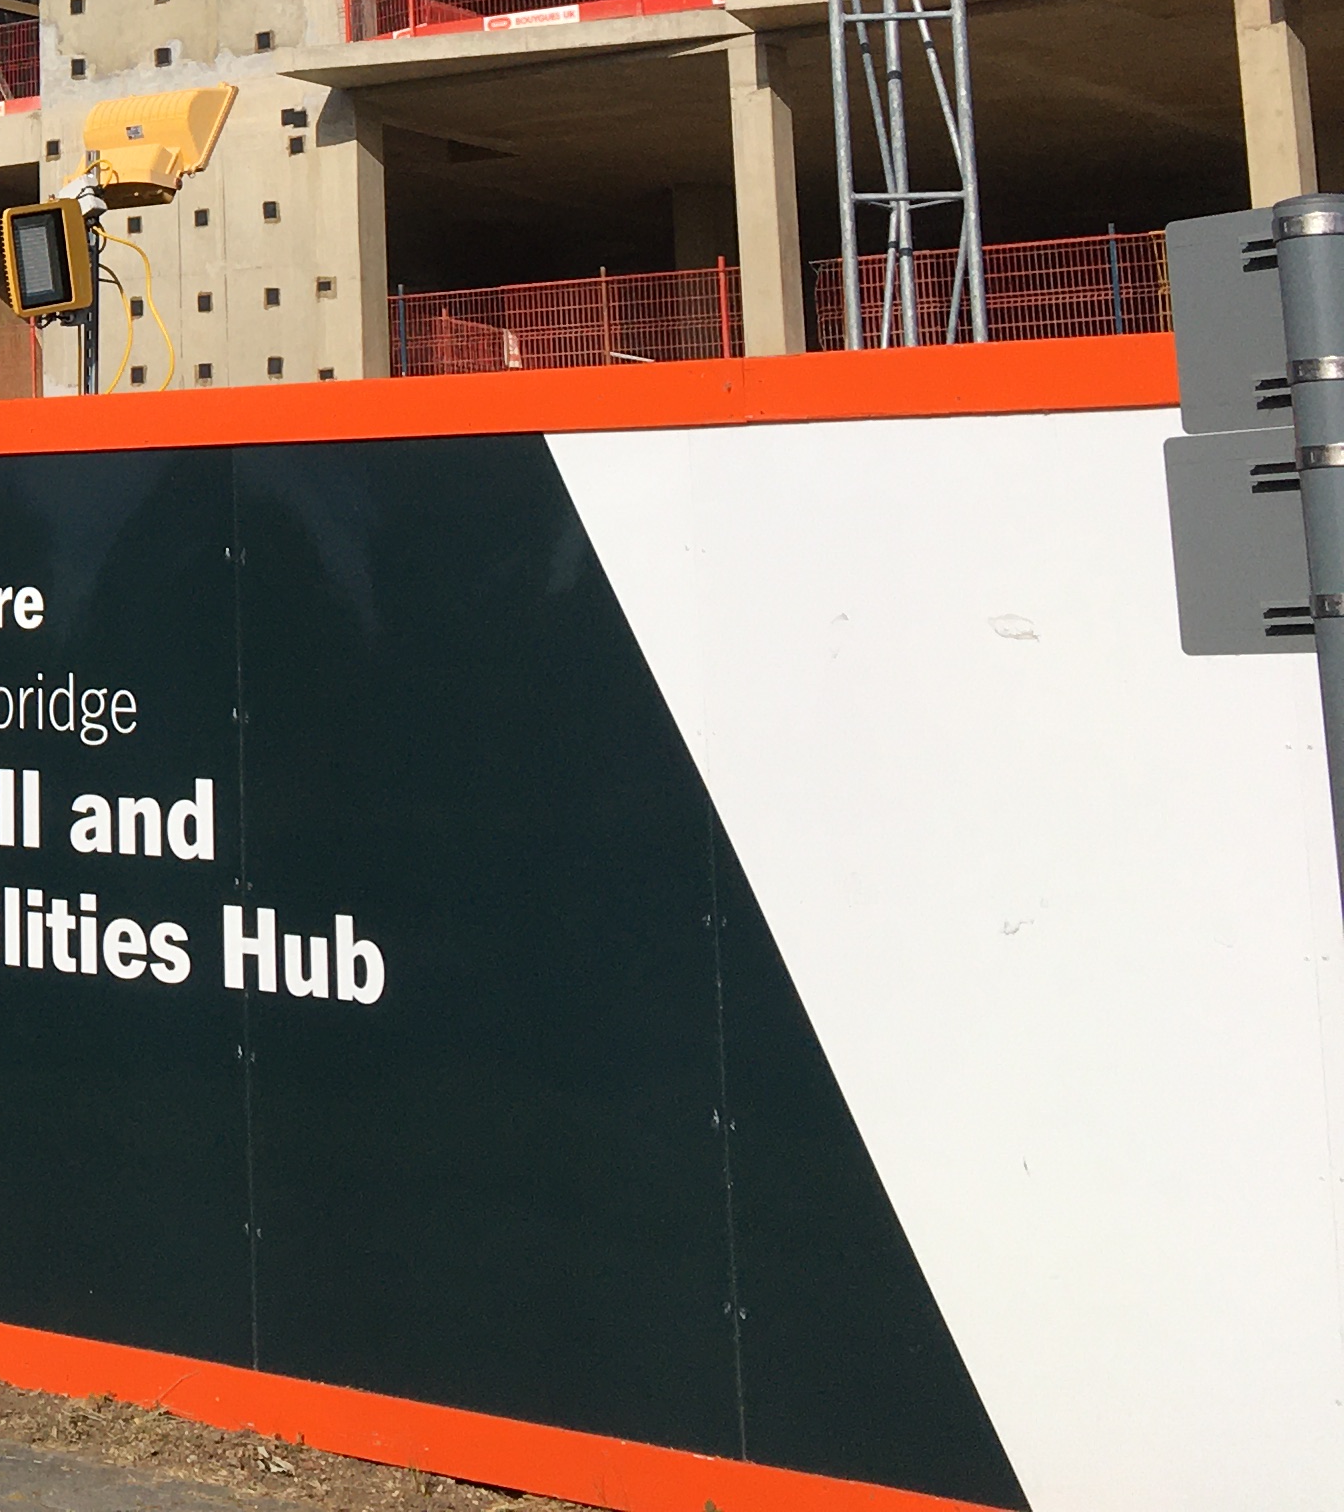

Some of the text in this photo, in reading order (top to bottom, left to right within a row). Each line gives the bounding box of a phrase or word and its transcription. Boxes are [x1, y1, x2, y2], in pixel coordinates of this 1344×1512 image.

[515, 12, 561, 26] BOUYGUES
[69, 777, 215, 861] and
[223, 904, 385, 1005] Hub
